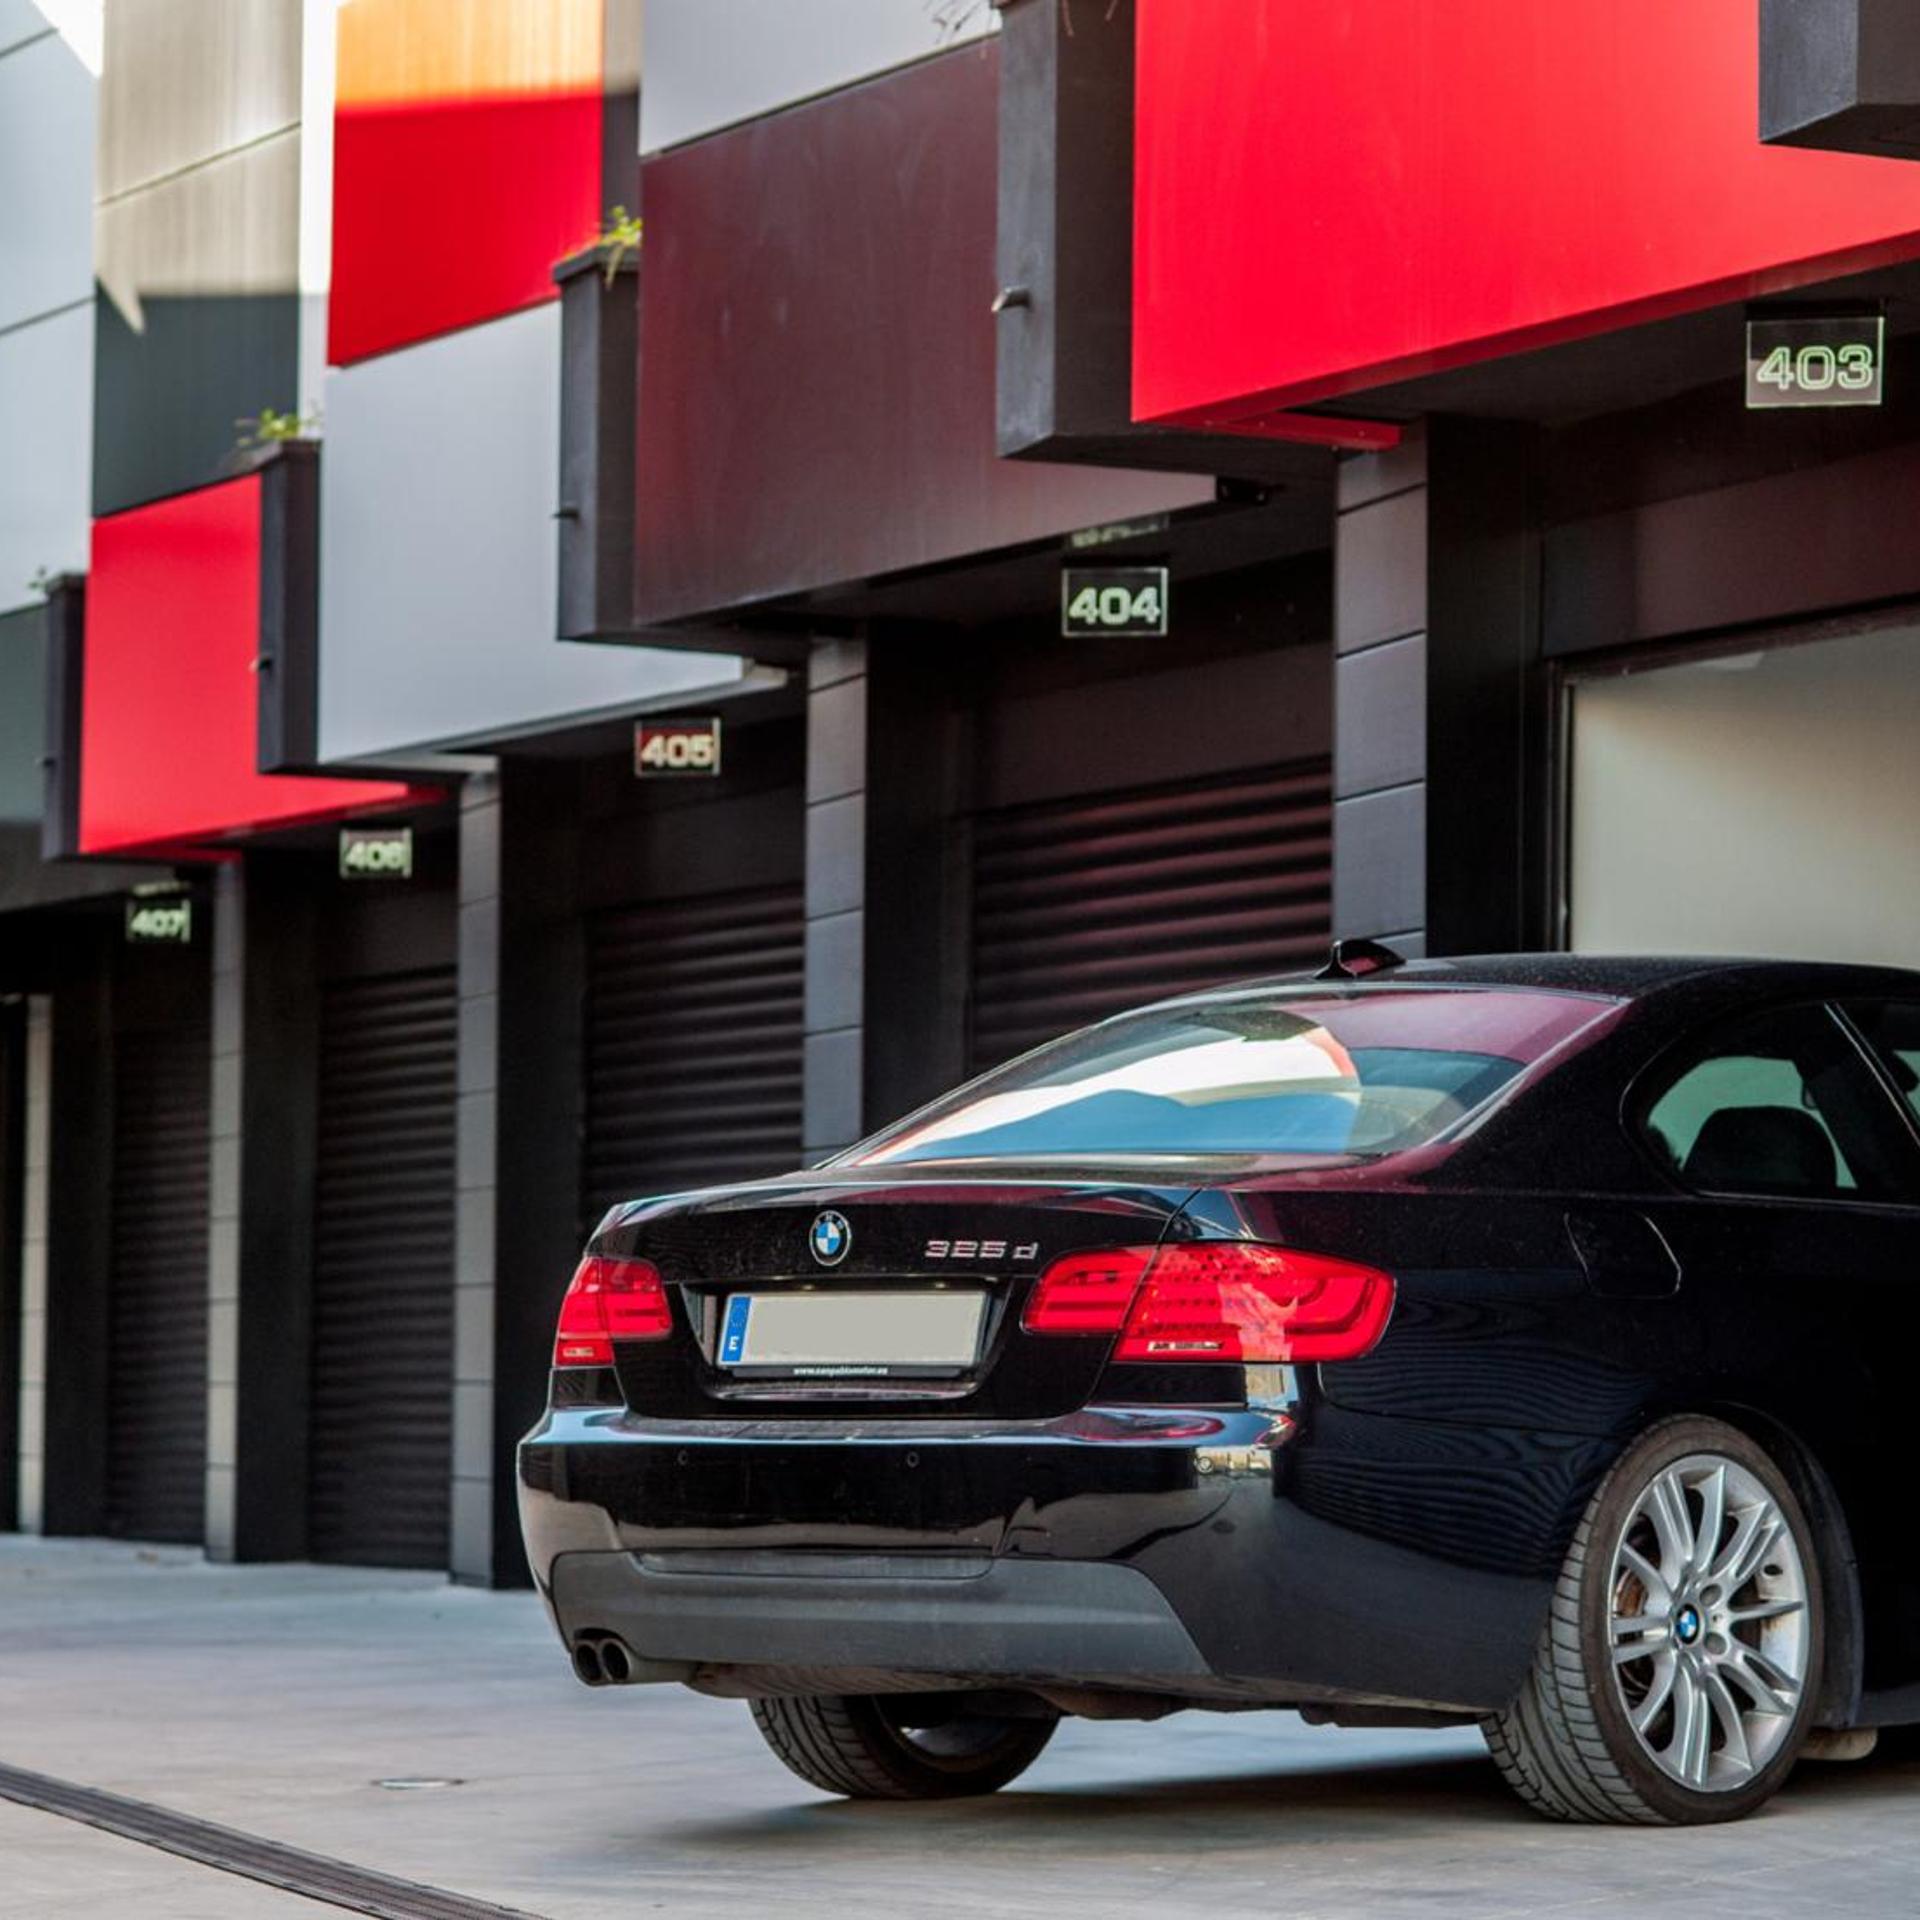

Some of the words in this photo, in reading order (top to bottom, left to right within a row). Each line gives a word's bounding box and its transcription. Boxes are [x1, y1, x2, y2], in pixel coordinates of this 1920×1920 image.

[1756, 344, 1873, 390] 403
[1068, 586, 1161, 625] 404
[641, 734, 715, 767] 405
[924, 1240, 1007, 1258] 325
[1012, 1241, 1039, 1260] d
[728, 1335, 740, 1351] E
